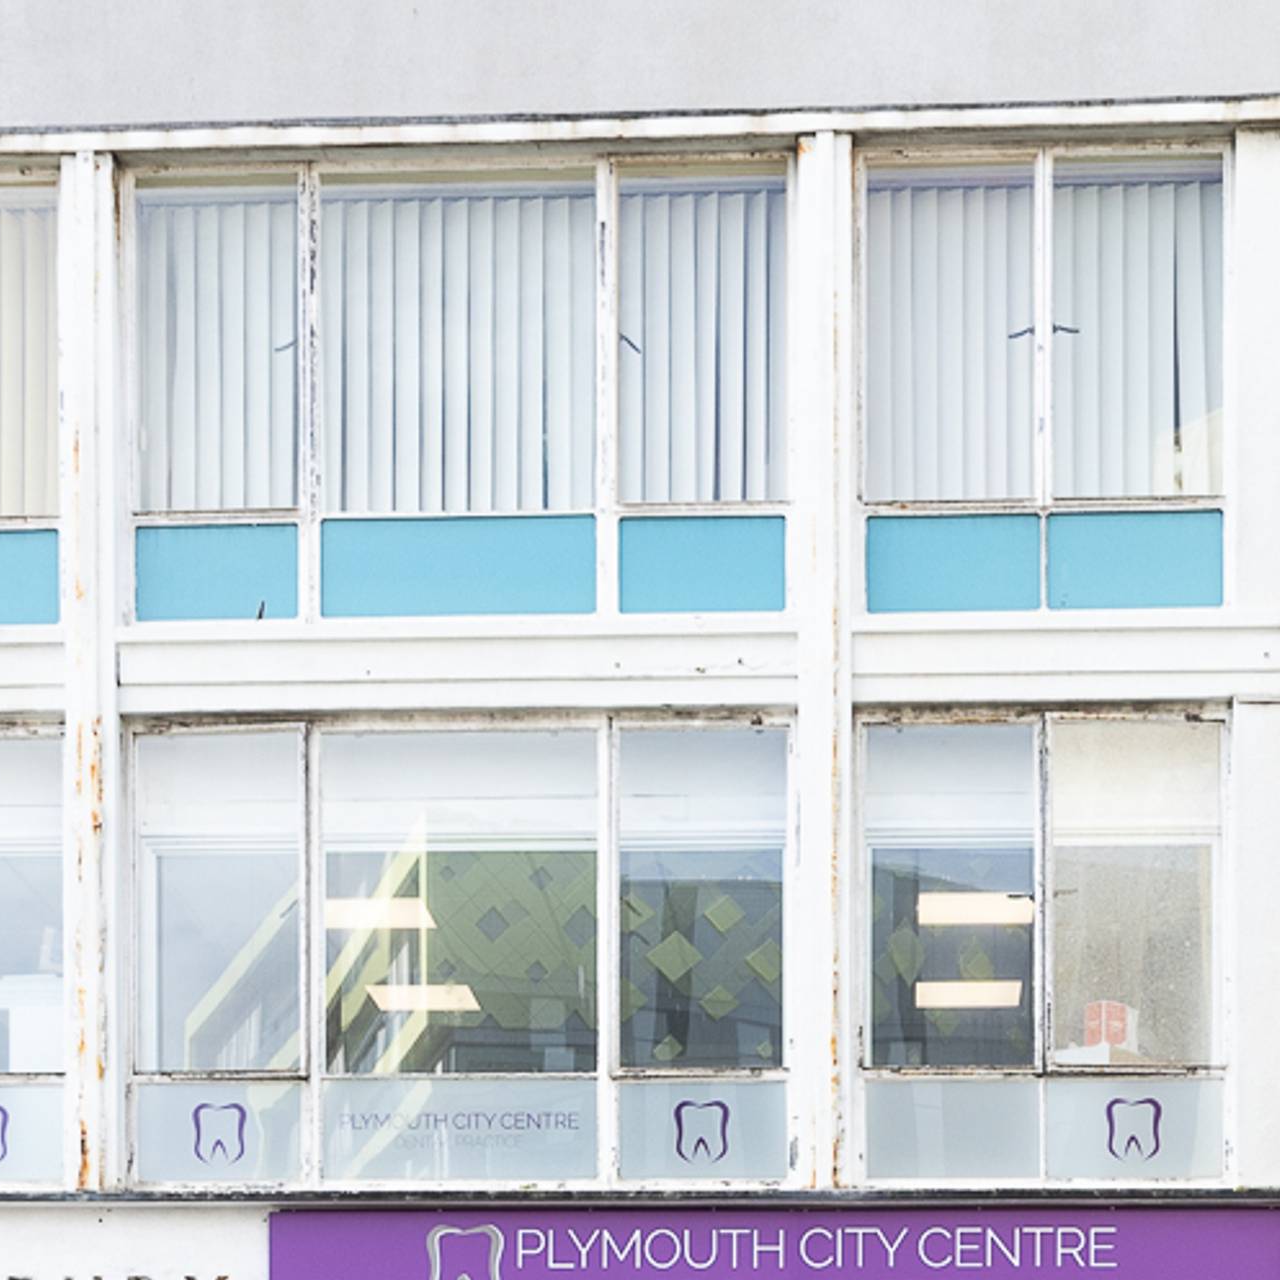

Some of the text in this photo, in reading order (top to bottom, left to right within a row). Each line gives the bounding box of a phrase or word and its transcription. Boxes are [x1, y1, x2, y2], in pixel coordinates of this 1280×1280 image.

[451, 1112, 497, 1130] CITY
[499, 1112, 580, 1130] CENTRE
[515, 1226, 1119, 1270] PLYMOUTH CITY CENTRE
